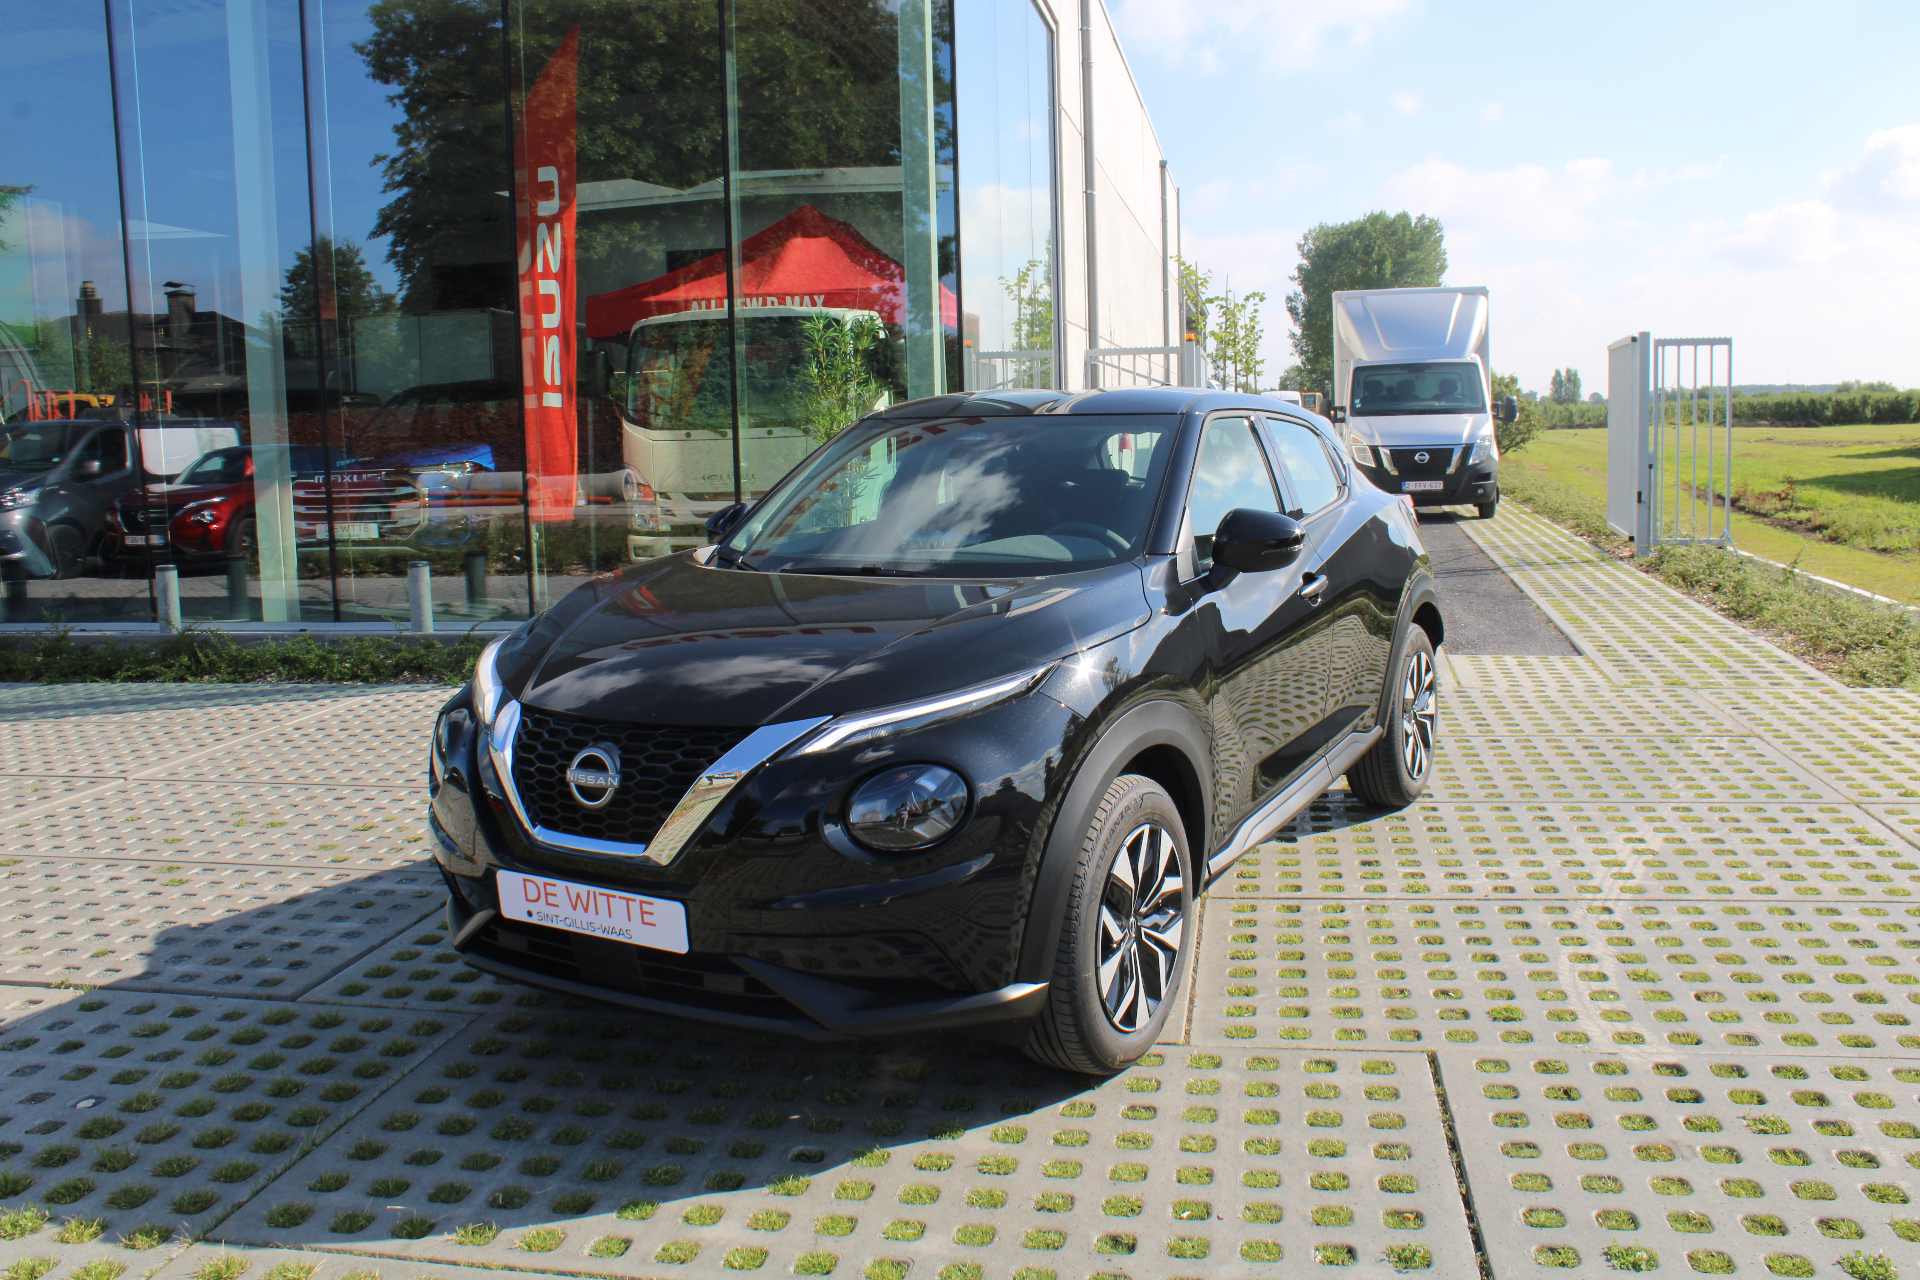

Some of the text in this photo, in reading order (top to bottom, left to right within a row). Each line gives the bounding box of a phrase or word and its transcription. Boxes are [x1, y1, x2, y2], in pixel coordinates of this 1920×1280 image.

[537, 166, 562, 408] ISUZU
[767, 295, 825, 308] D-MAX
[567, 771, 619, 787] NISSAN
[522, 877, 657, 928] DE WITTE
[536, 911, 633, 940] SINT-GILLIS-WAAS
